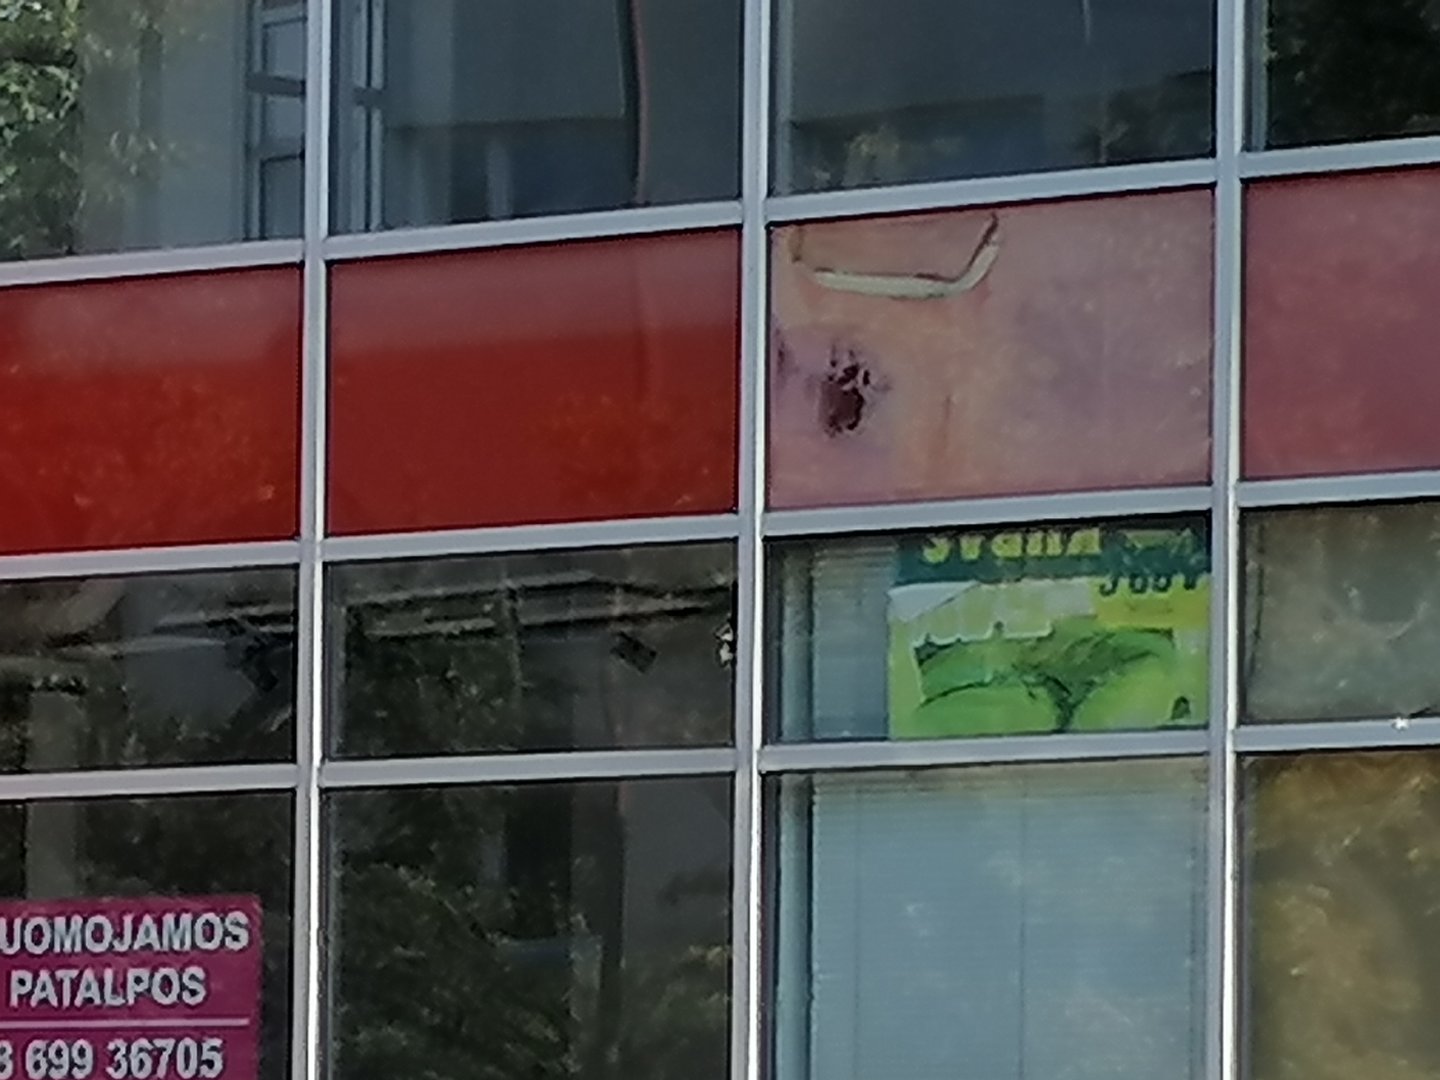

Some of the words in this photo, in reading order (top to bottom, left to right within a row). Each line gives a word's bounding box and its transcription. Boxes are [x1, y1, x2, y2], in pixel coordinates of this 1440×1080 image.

[10, 966, 207, 1008] PATALPOS
[25, 1038, 94, 1080] 699
[105, 1037, 224, 1080] 36705
